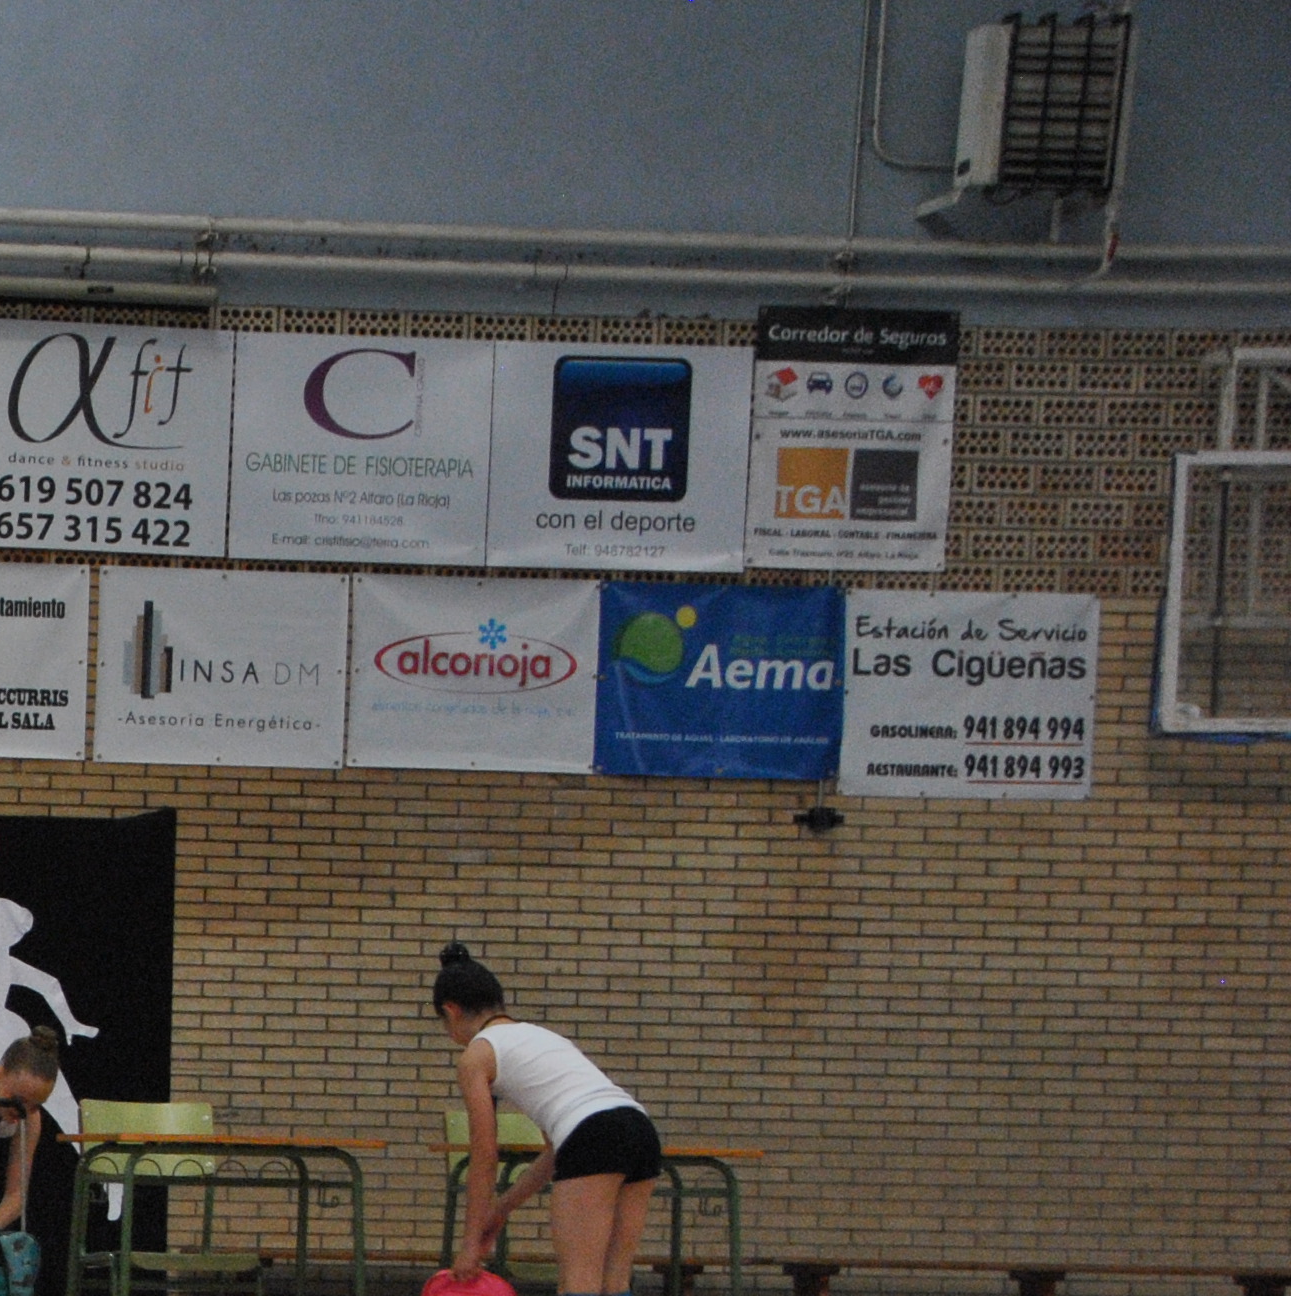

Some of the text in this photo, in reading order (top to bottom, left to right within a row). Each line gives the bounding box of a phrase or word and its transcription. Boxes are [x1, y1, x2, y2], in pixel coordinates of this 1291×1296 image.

[769, 324, 947, 349] Corredor de Seguros
[304, 348, 416, 440] C
[569, 426, 673, 471] SNT
[8, 453, 185, 472] dance & fitness studio
[245, 451, 474, 478] GABINETE DE FISIOTERAPIA
[65, 478, 124, 507] 507
[133, 481, 193, 510] 824
[273, 489, 291, 502] Las
[566, 474, 672, 490] INFORMATICA
[776, 485, 846, 514] TGA
[64, 515, 122, 544] 315
[131, 518, 191, 547] 422
[536, 510, 696, 536] con el deporte
[856, 616, 949, 640] Estación
[961, 619, 988, 641] de
[998, 619, 1087, 642] Servicio
[180, 659, 319, 686] INSA DM
[397, 638, 551, 687] alcorioja
[684, 644, 834, 690] Aema
[852, 647, 1086, 686] Las Cigüeñas
[11, 713, 55, 730] SALA
[963, 716, 997, 739] 941
[1004, 716, 1040, 740] 894
[1048, 716, 1085, 741] 994
[965, 754, 998, 778] 941
[1004, 755, 1040, 779] 894
[1048, 755, 1085, 779] 993
